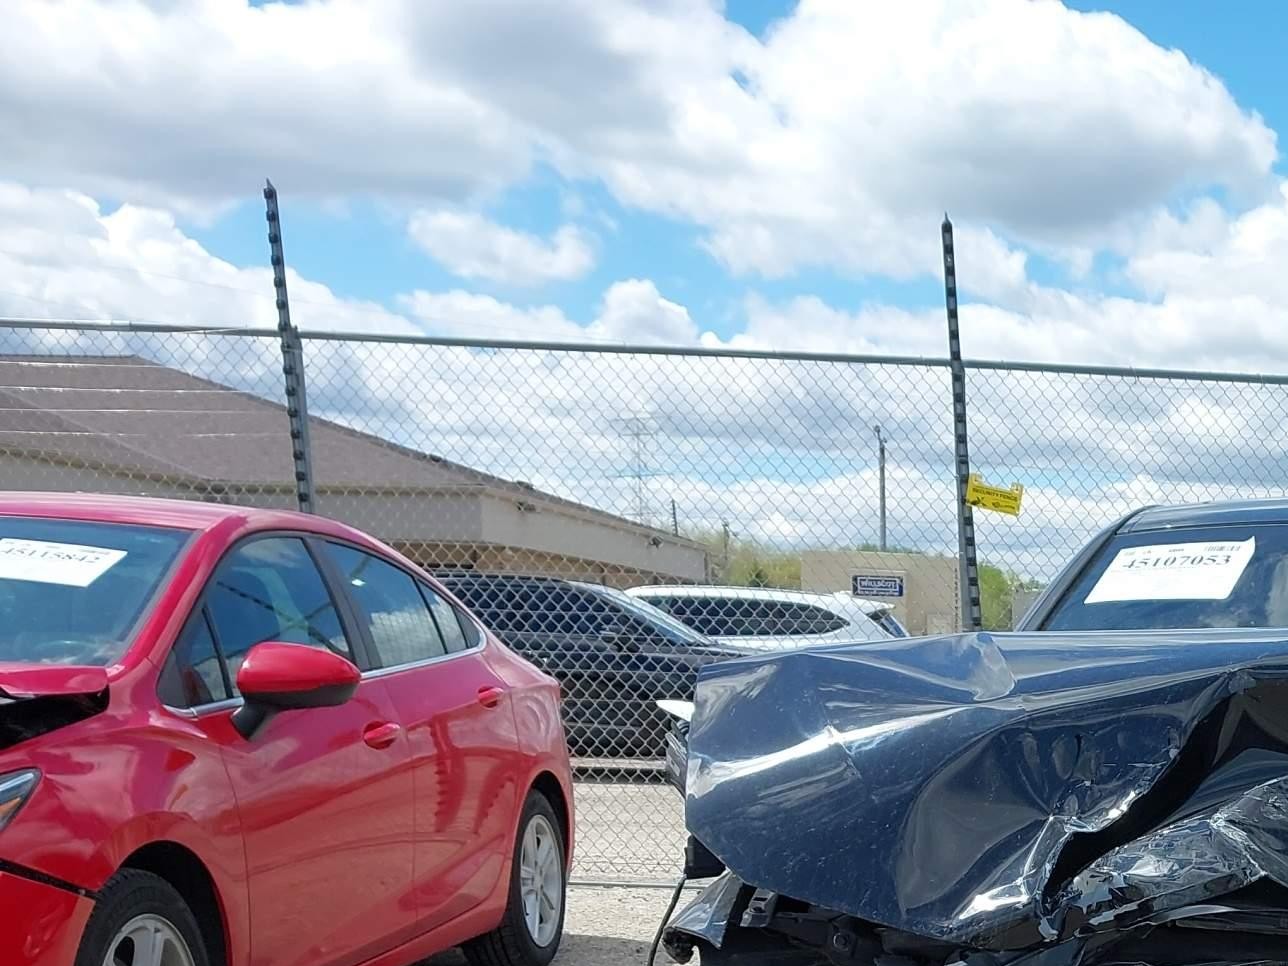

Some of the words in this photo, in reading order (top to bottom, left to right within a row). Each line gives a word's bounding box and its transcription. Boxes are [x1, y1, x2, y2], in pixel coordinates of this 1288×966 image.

[972, 487, 999, 497] SECURITY
[1000, 493, 1018, 502] FENCE
[1122, 555, 1232, 569] 45107053
